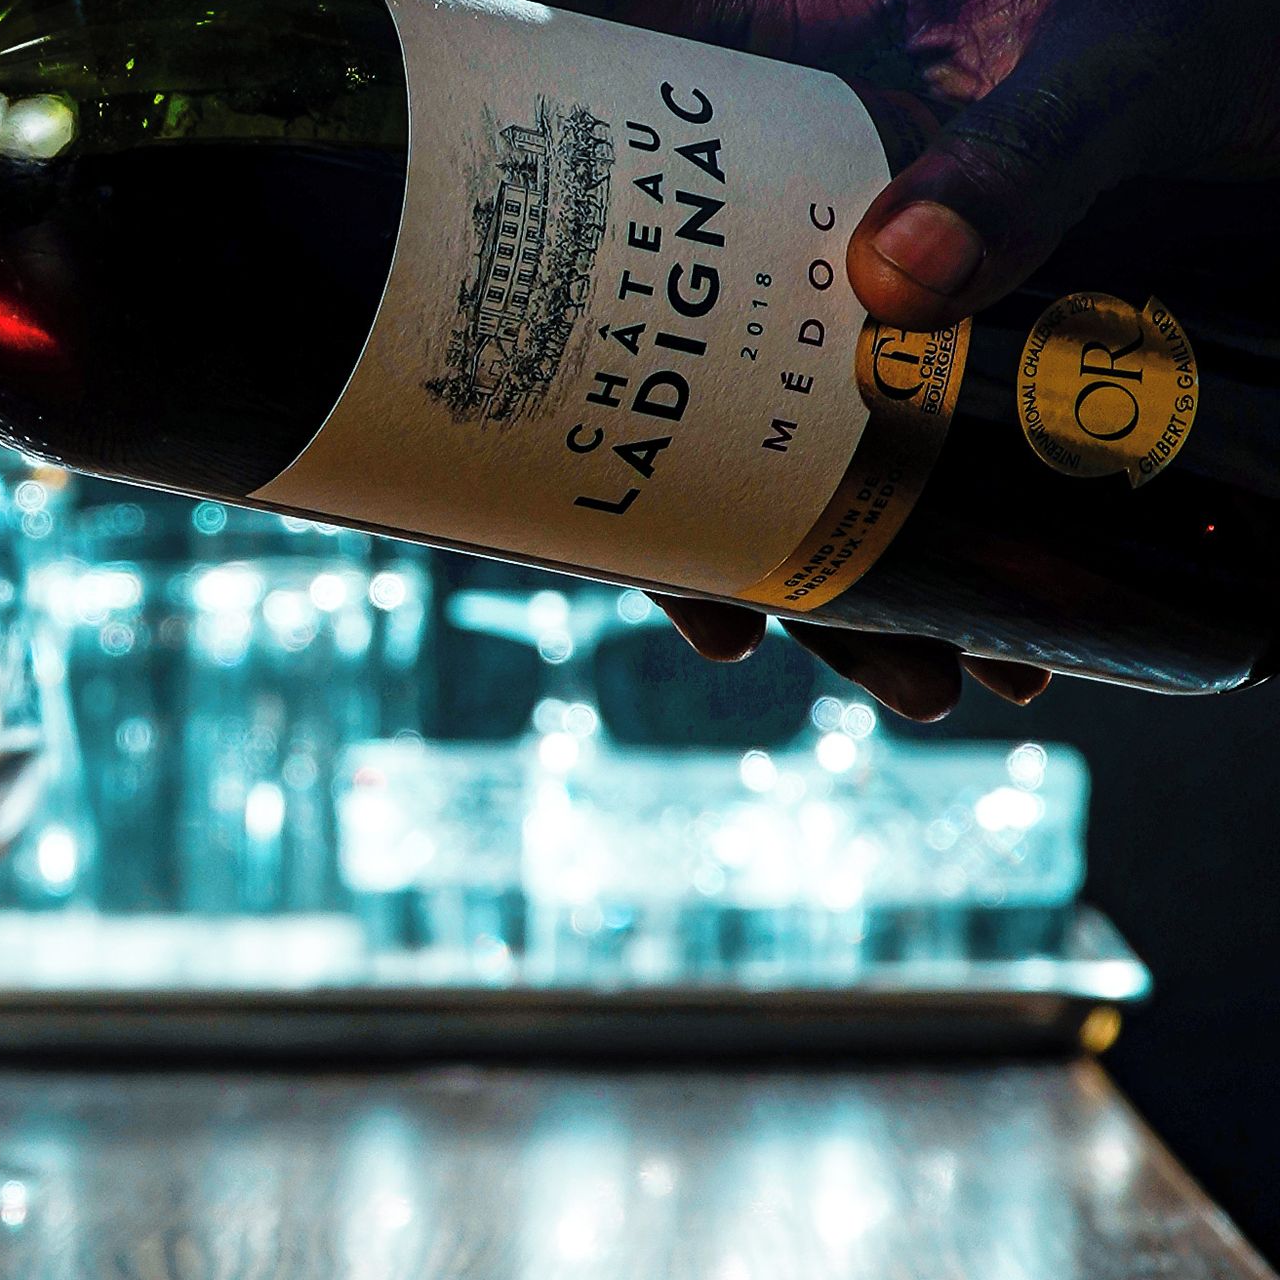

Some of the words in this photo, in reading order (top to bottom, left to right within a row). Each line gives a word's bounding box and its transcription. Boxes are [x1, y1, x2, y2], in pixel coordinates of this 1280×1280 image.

[566, 121, 664, 454] CHÂTEAU
[574, 81, 726, 515] LADIGNAC
[740, 272, 773, 361] 2018
[761, 202, 836, 453] MÉDOC
[920, 341, 939, 379] CRU
[924, 323, 954, 415] BOURGEO
[1023, 306, 1066, 378] CHALLENGE
[1074, 326, 1145, 441] OR
[1152, 309, 1194, 389] GAILLARD
[1022, 382, 1081, 469] INTERNATIONAL
[1139, 414, 1187, 474] GILBERT
[784, 544, 835, 588] GRAND
[831, 509, 861, 540] VIN
[784, 537, 862, 601] BORDEAUX
